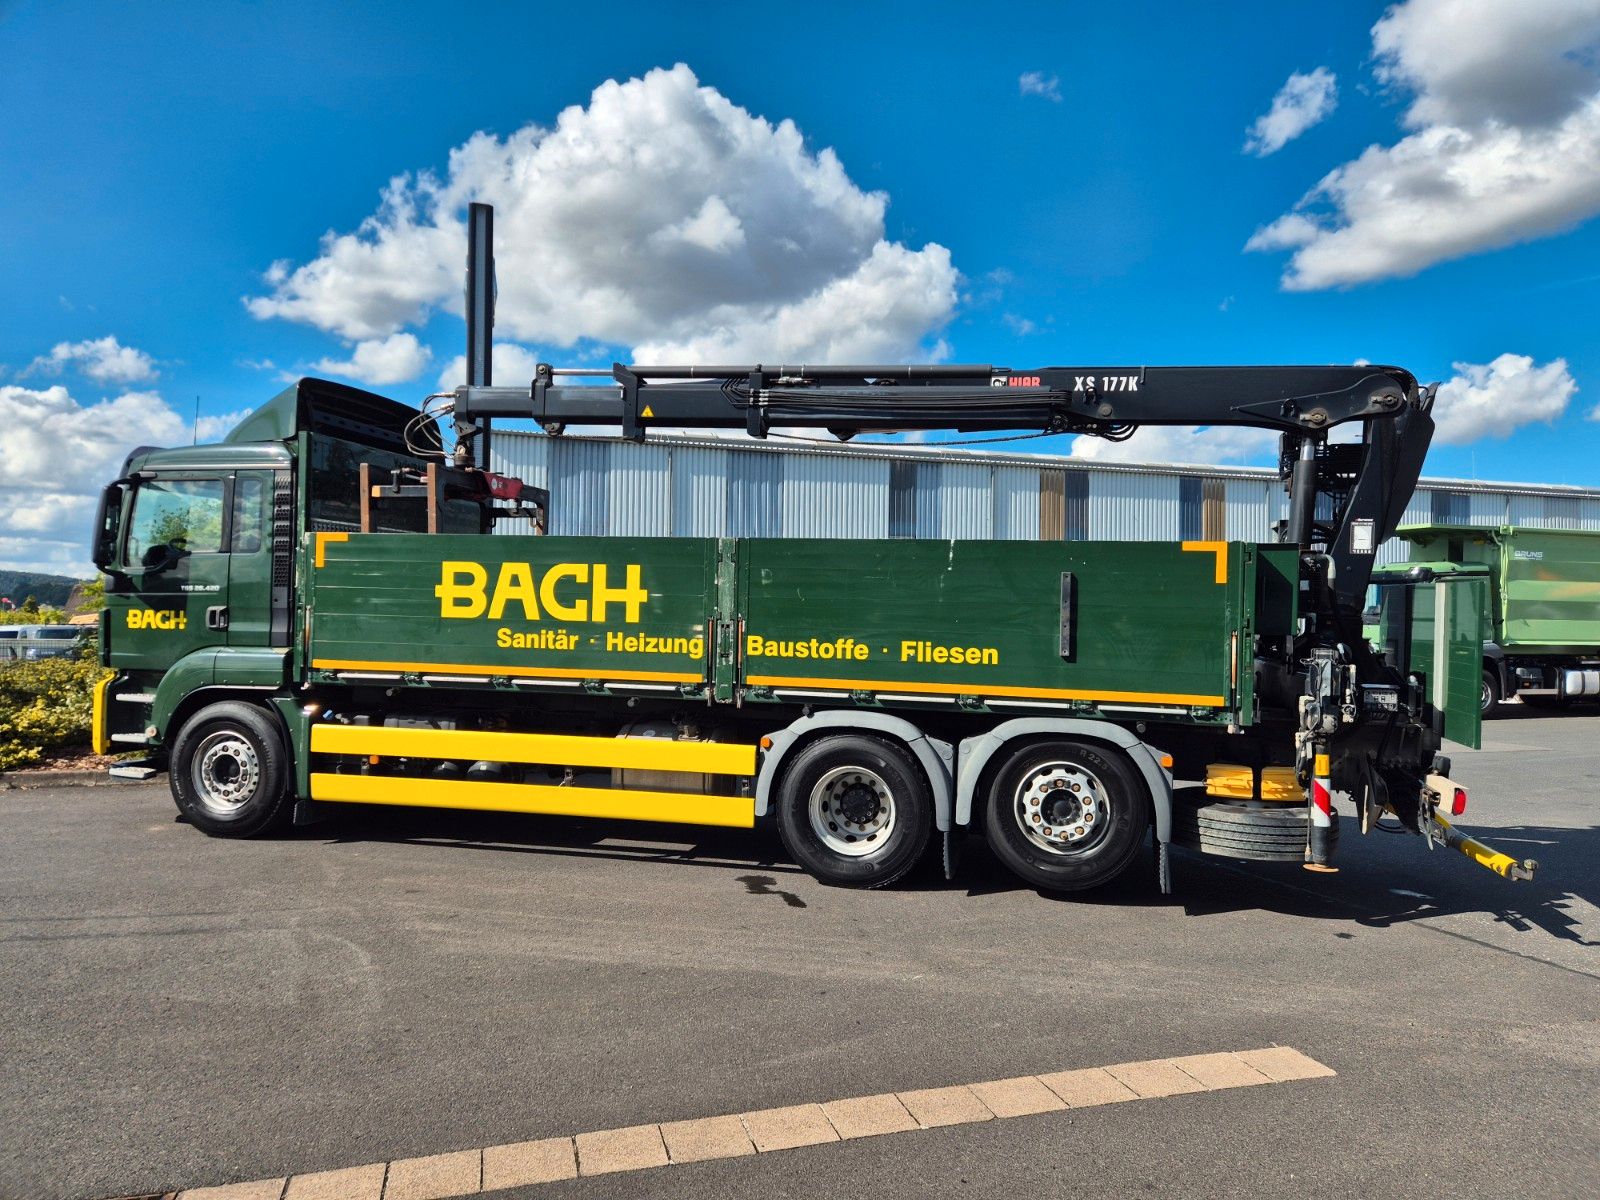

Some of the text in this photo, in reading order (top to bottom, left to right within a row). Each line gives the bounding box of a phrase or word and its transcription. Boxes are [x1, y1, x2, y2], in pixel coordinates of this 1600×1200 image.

[1073, 376, 1138, 392] XS 177K
[1514, 550, 1544, 558] BRUNS
[434, 561, 648, 623] BACH
[126, 609, 188, 630] BACH
[496, 628, 705, 660] Sanitär Heizung
[746, 635, 999, 665] Baustoffe Fliesen
